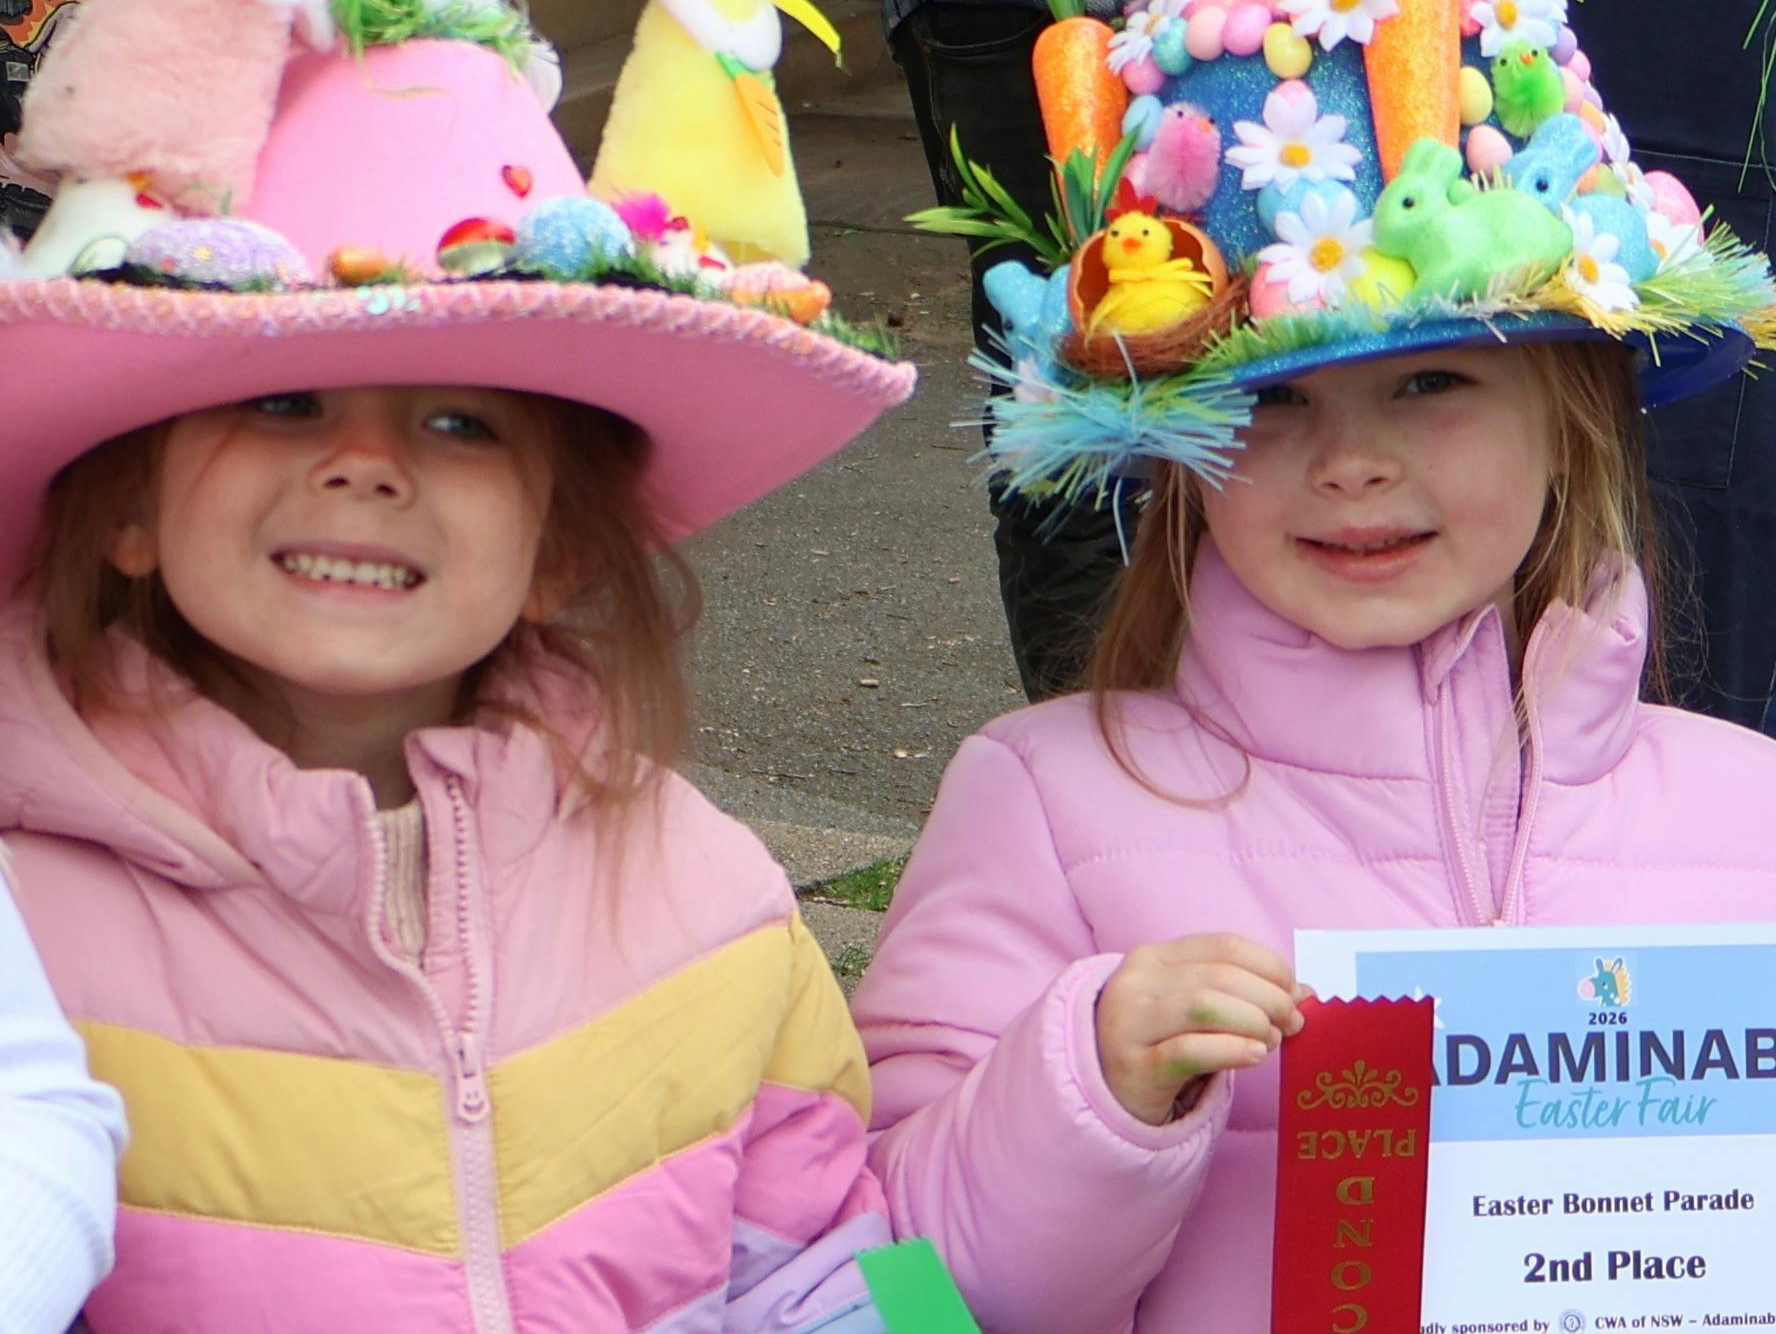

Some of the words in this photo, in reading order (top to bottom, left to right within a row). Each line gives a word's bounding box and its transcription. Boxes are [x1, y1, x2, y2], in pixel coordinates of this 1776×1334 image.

[1588, 1011, 1629, 1026] 2026
[1515, 1074, 1630, 1130] Easter
[1635, 1074, 1718, 1127] Fair
[1296, 1127, 1417, 1161] PLACE
[1473, 1192, 1554, 1218] Easter
[1562, 1190, 1655, 1216] Bonnet
[1663, 1187, 1756, 1213] Parade
[1523, 1251, 1594, 1283] 2nd
[1607, 1248, 1708, 1281] Place
[1533, 1318, 1551, 1334] by
[1594, 1316, 1627, 1330] CWA
[1632, 1315, 1646, 1329] of
[1650, 1314, 1684, 1328] NSW
